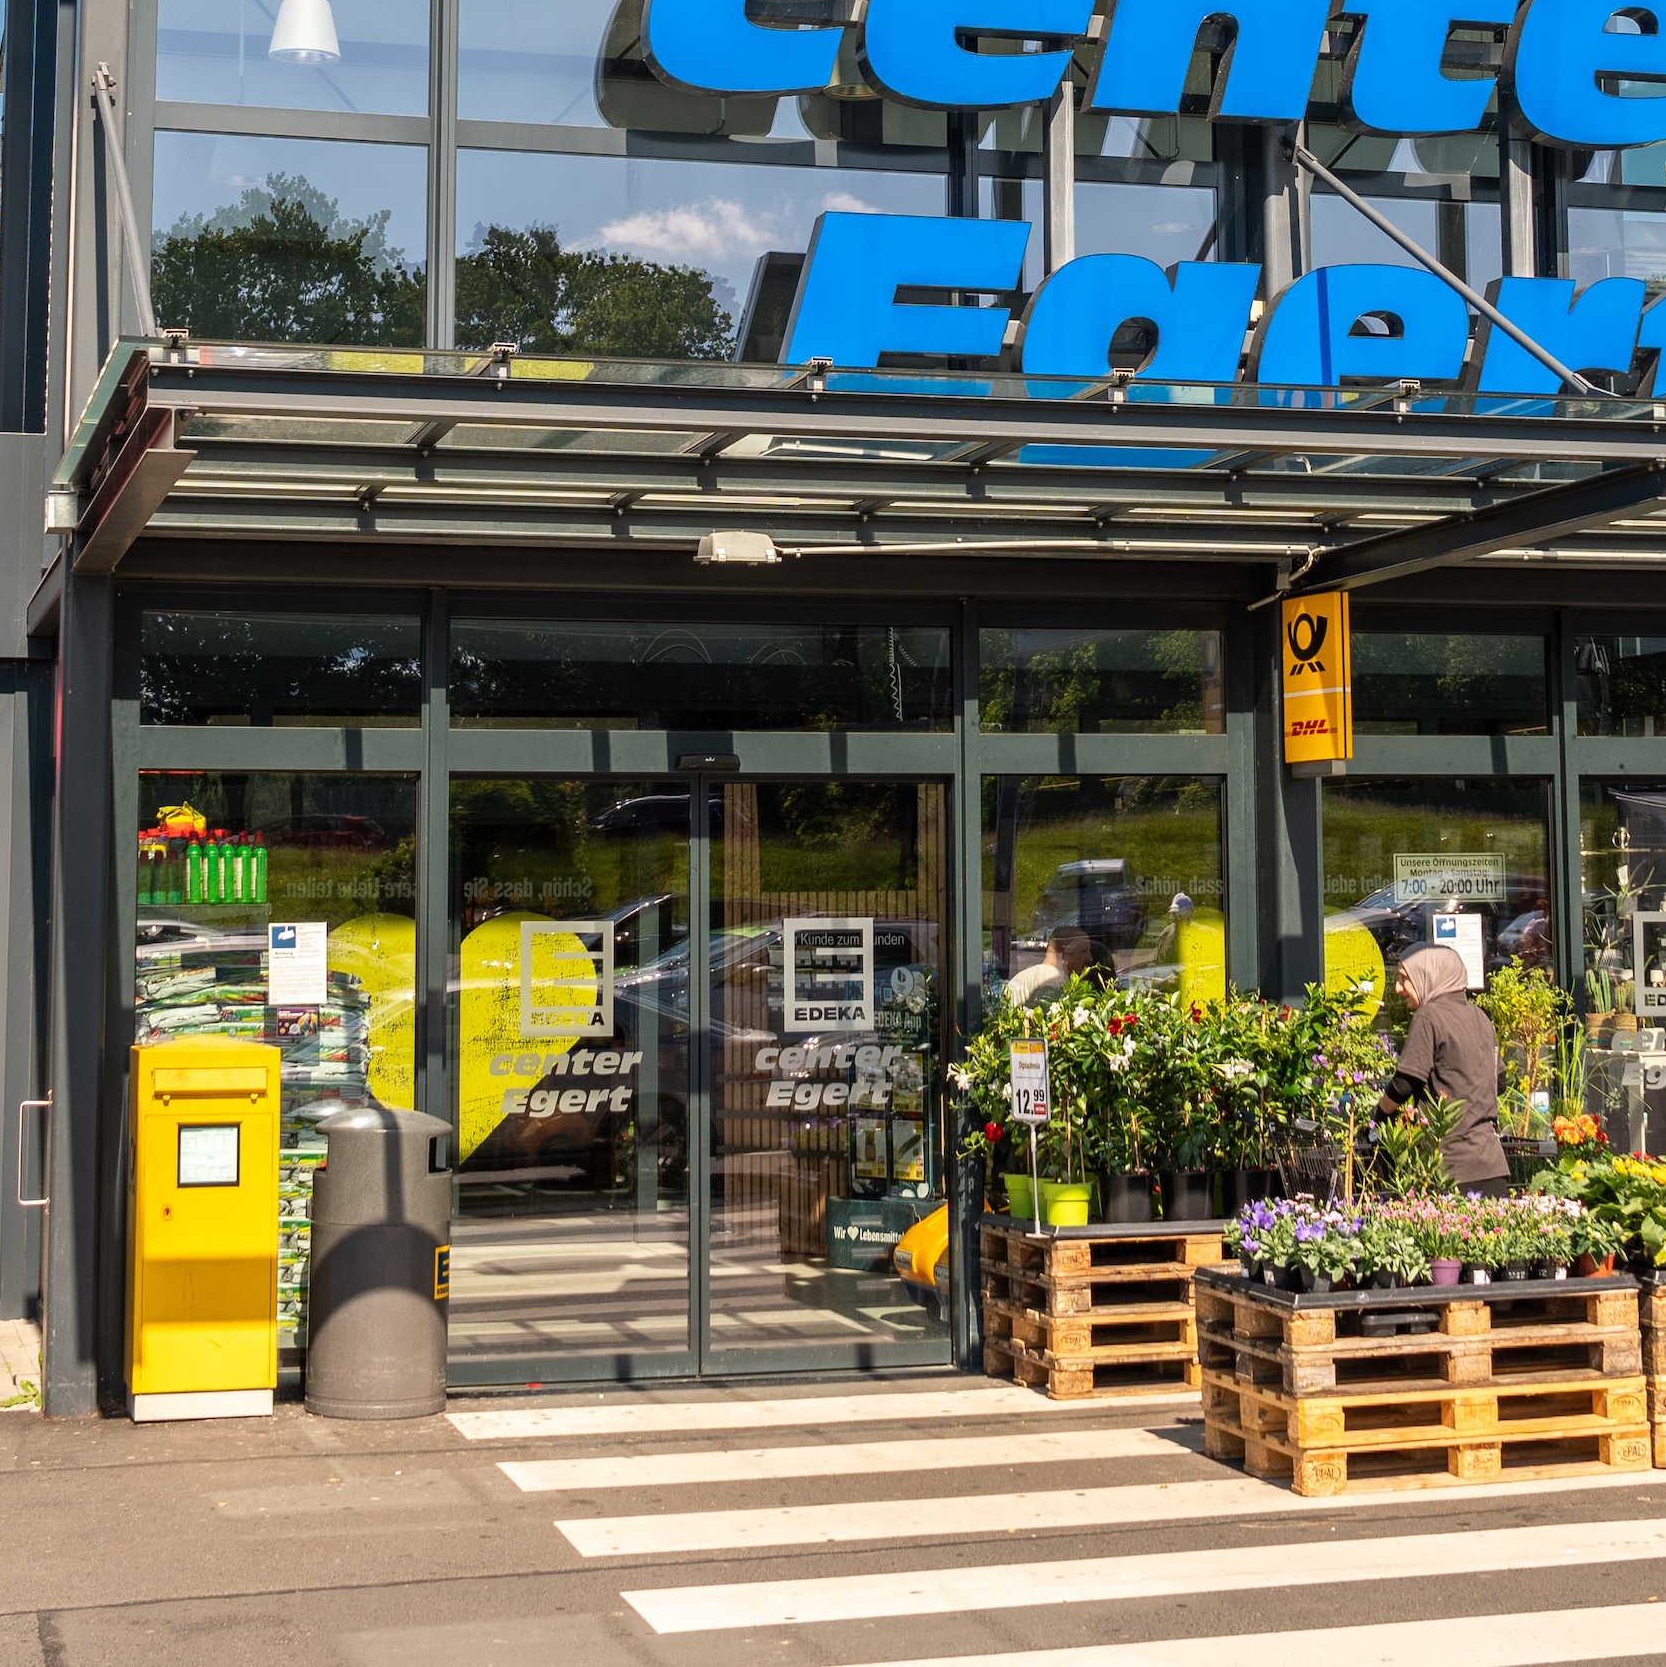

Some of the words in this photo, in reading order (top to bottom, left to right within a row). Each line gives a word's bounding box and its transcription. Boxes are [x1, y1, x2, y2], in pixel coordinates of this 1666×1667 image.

[1290, 719, 1329, 737] DHL
[1400, 858, 1430, 867] Unsere
[1432, 857, 1499, 867] Öffnungszeiten
[1410, 869, 1443, 878] Montag
[1450, 869, 1490, 878] Samstag:
[1401, 879, 1427, 894] 7:00
[1439, 879, 1473, 894] 20:00
[1476, 878, 1500, 893] Uhr
[800, 932, 834, 946] Kunde
[837, 934, 860, 946] zum
[873, 933, 905, 946] unden
[794, 1006, 866, 1021] EDEKA
[489, 1048, 644, 1076] center
[755, 1043, 904, 1071] center
[500, 1084, 633, 1118] Egert
[766, 1080, 893, 1111] Egert
[834, 1225, 847, 1240] Wir
[1622, 1445, 1642, 1457] EPAL
